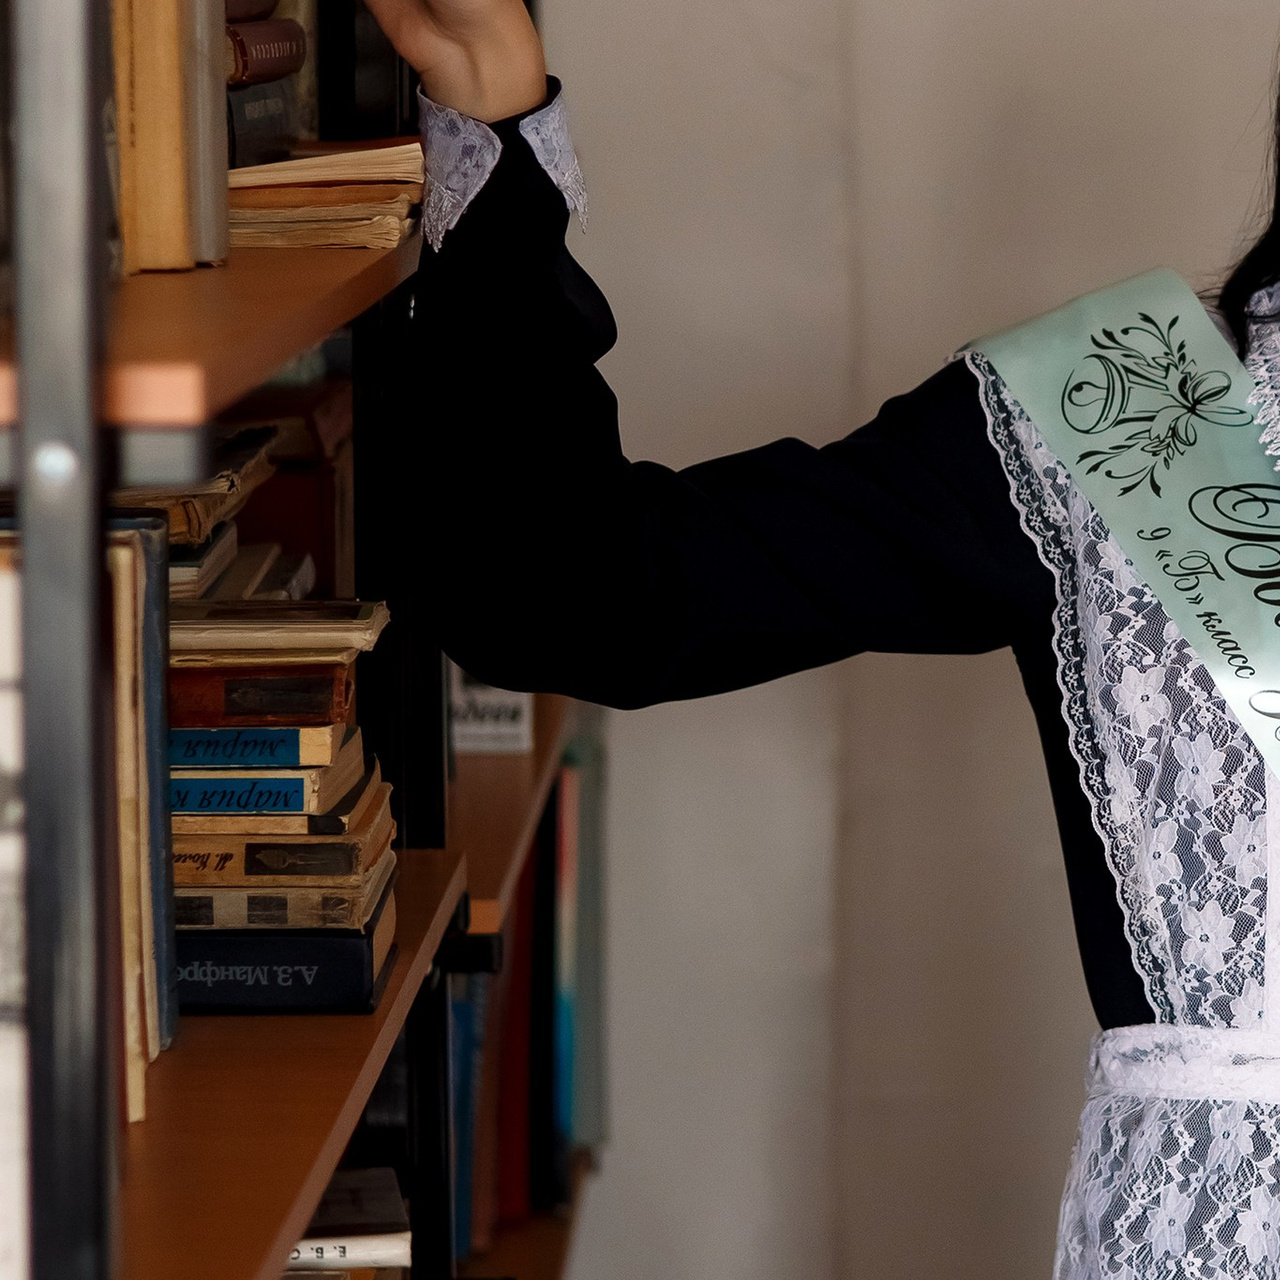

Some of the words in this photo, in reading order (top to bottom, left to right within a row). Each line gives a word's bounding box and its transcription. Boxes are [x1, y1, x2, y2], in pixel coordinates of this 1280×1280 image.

[1136, 526, 1172, 541] 9
[1195, 611, 1257, 680] класс
[184, 731, 287, 761] мария
[198, 781, 300, 810] мария
[175, 960, 270, 988] Манфре
